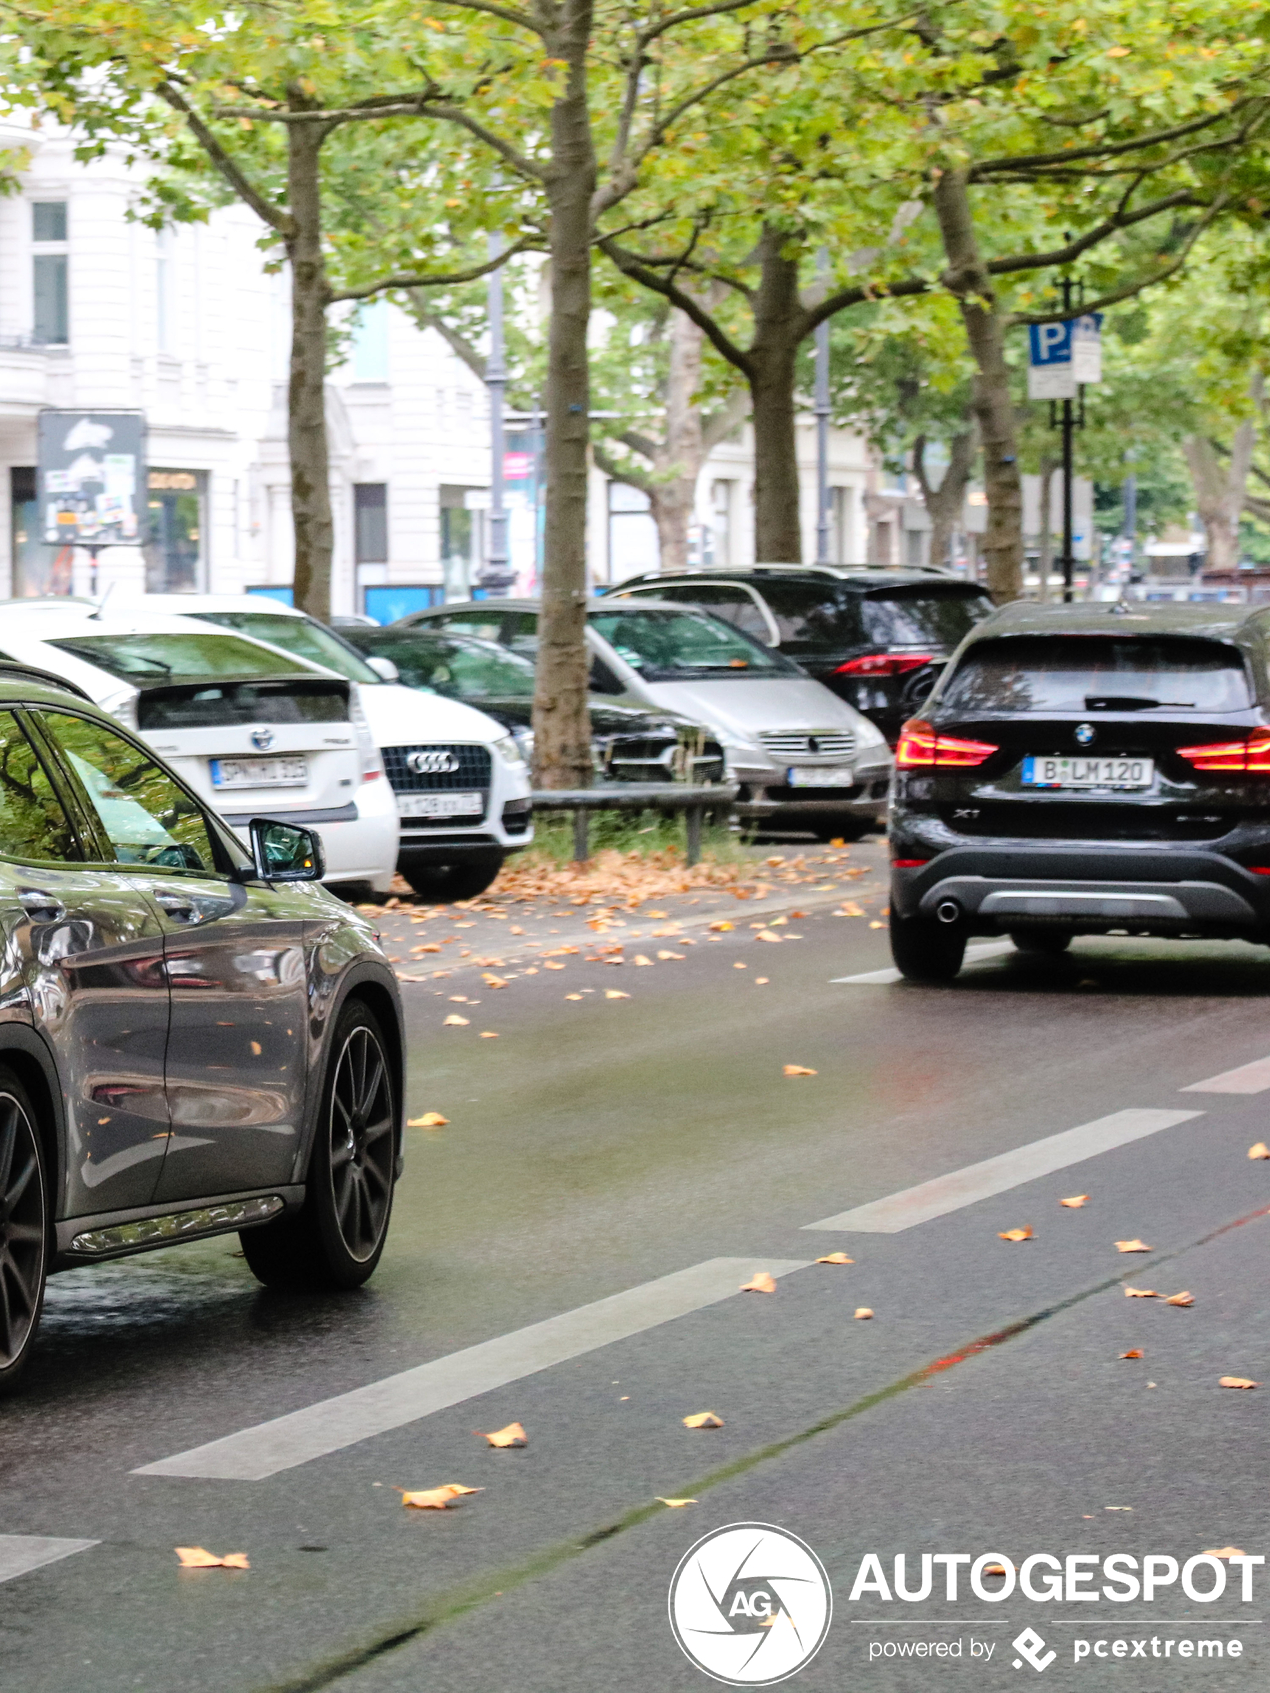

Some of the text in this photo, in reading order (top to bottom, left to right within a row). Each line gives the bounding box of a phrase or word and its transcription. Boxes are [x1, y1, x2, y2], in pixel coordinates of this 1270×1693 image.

[1038, 322, 1066, 360] P
[1044, 761, 1143, 781] B LM 120
